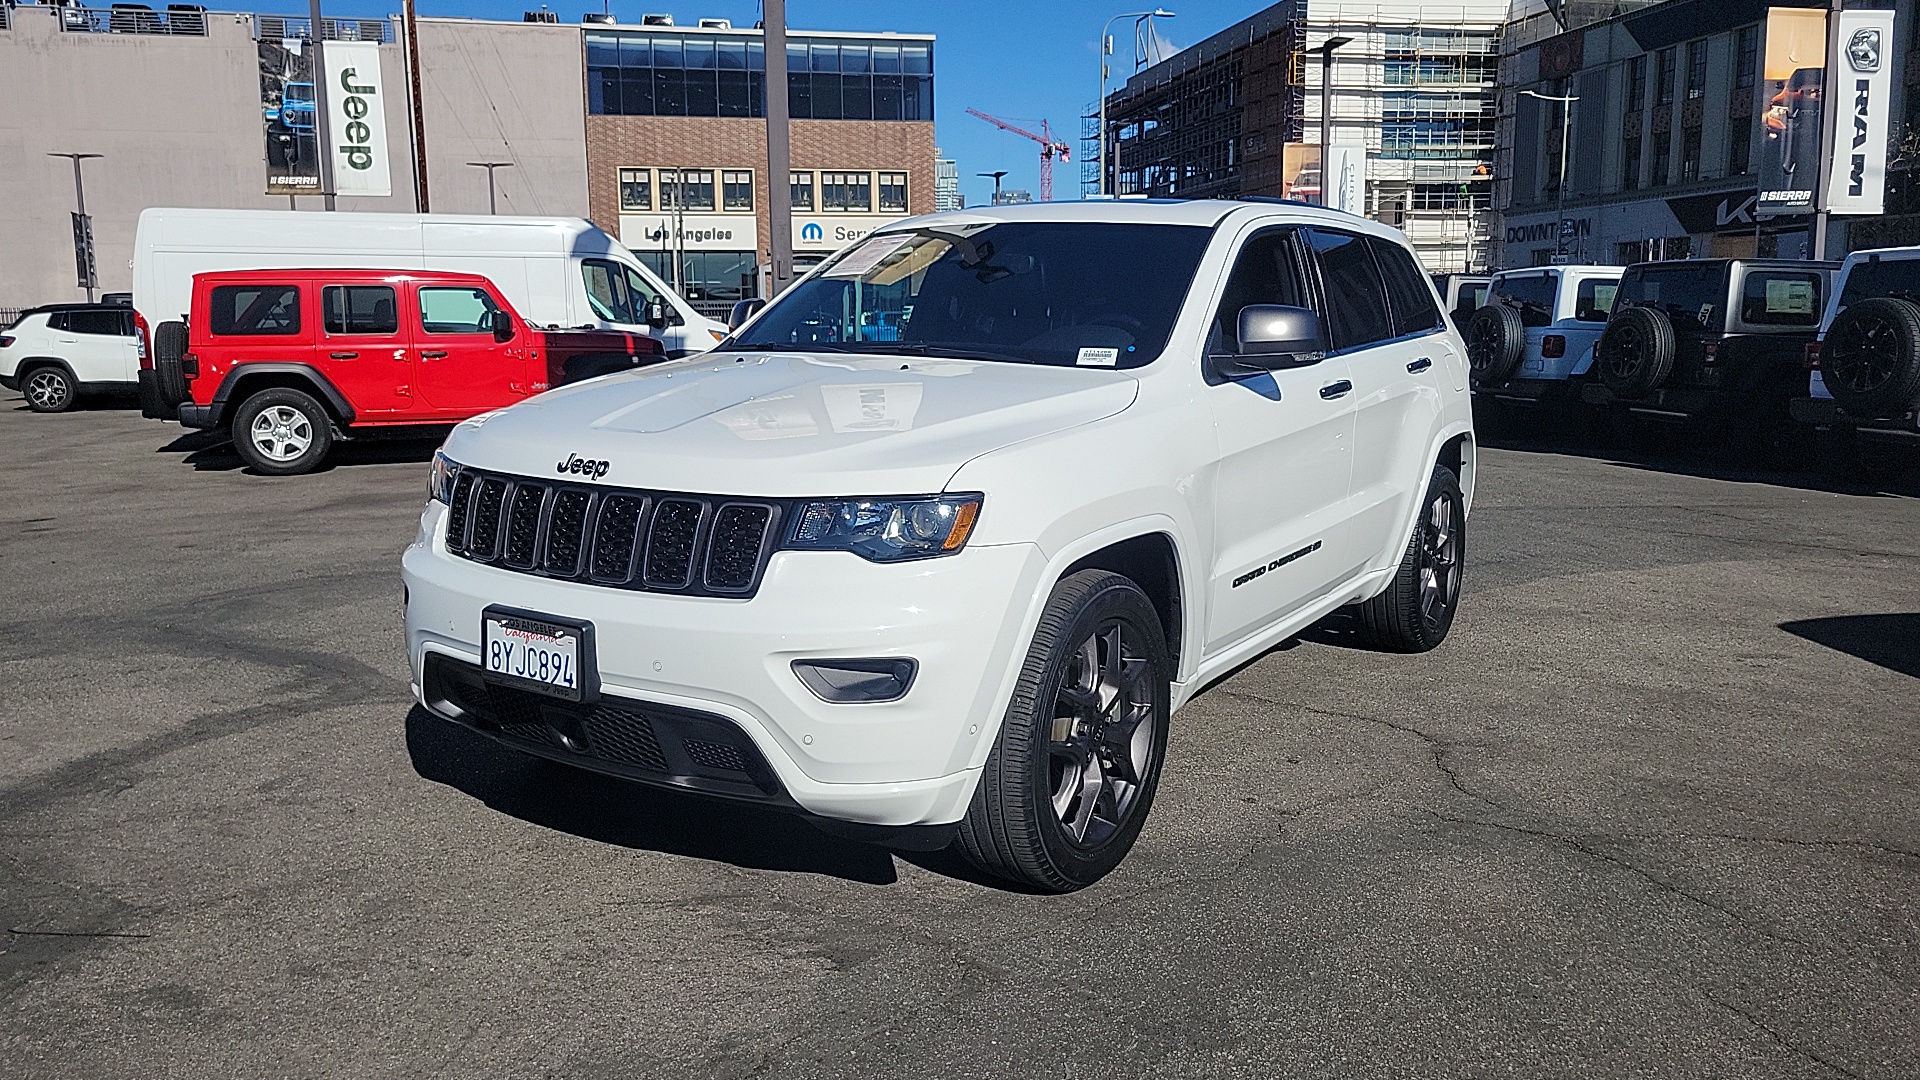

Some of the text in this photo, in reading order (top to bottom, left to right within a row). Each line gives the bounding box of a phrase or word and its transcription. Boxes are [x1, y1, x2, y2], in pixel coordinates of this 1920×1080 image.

[339, 67, 376, 170] Jeep
[1848, 79, 1870, 196] RAM
[277, 176, 318, 185] SIERRA
[1767, 190, 1812, 201] SIERRA
[675, 226, 732, 242] Angeles
[1507, 217, 1591, 243] DOWNTWN
[557, 452, 610, 481] Jeep
[491, 639, 574, 688] 8YJC894
